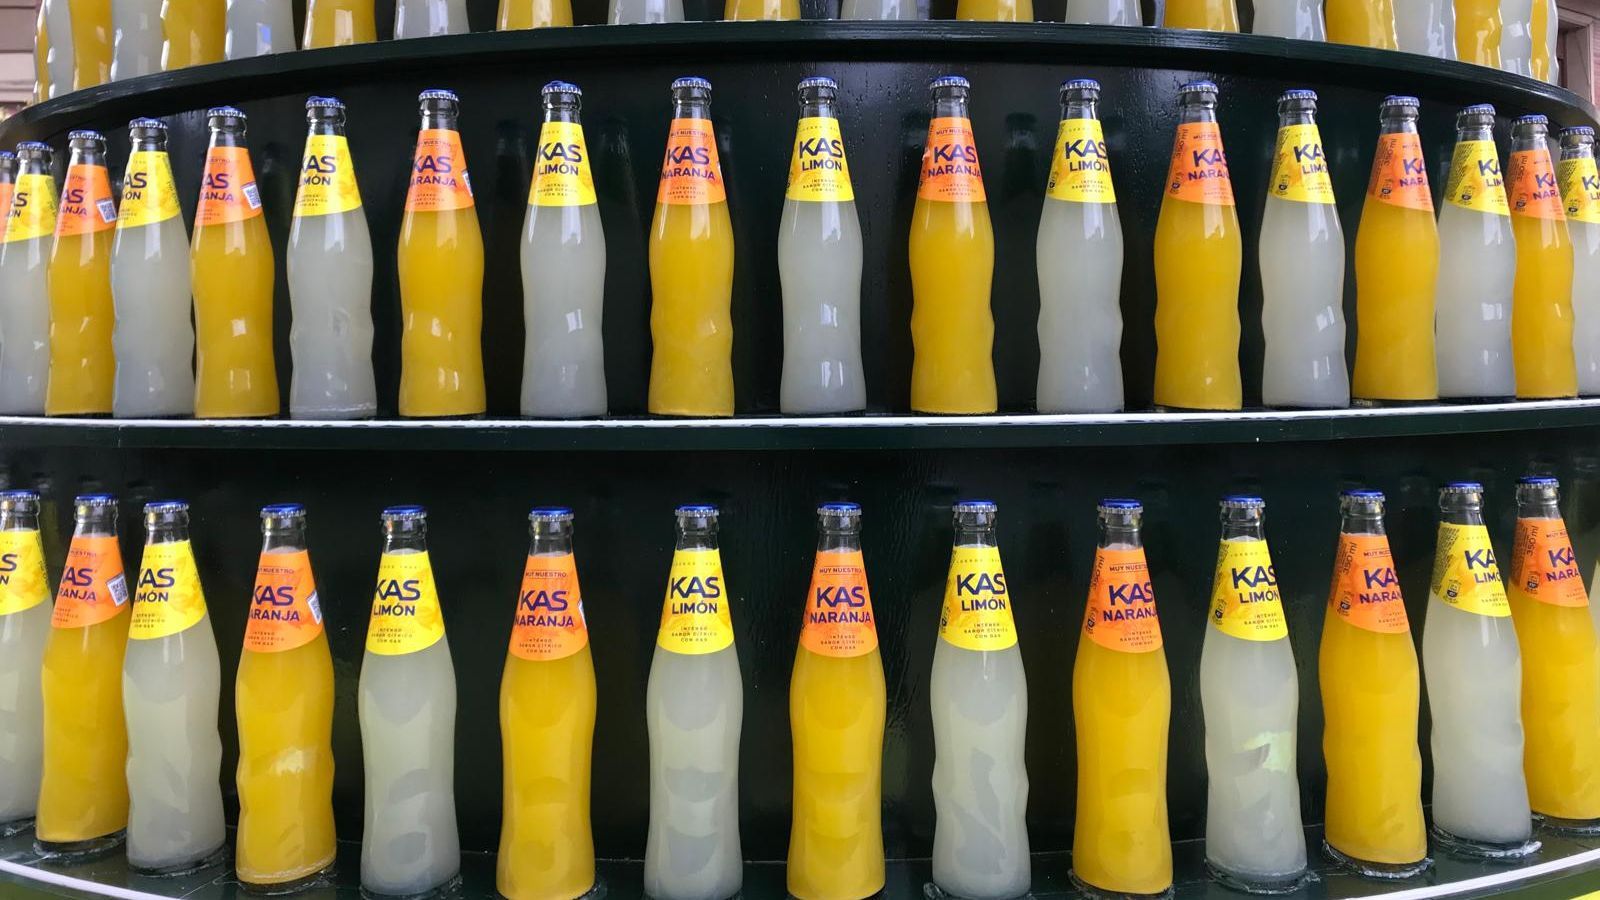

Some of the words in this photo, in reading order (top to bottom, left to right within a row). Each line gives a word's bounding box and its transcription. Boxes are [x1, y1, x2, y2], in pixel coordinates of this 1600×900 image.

[538, 142, 582, 163] KAS
[667, 146, 710, 166] KAS
[800, 138, 842, 158] KAS
[934, 144, 976, 163] KAS
[1065, 140, 1107, 159] KAS
[1294, 144, 1326, 163] KA
[539, 163, 579, 176] LIMÓN
[662, 168, 715, 180] NARANJA
[802, 158, 842, 171] LIMÓN
[1070, 160, 1108, 172] LIMÓN
[1403, 158, 1425, 175] KA
[123, 172, 148, 188] AS
[202, 173, 229, 189] AS
[1188, 168, 1229, 181] NARA
[63, 189, 84, 203] AS
[1464, 549, 1496, 570] KA
[1548, 546, 1575, 568] KA
[62, 566, 93, 586] AS
[139, 568, 175, 588] AS
[956, 573, 1006, 596] KAS
[1232, 565, 1277, 590] KAS
[1364, 568, 1398, 589] KA
[1546, 569, 1579, 582] NARA
[376, 580, 420, 601] KAS
[671, 576, 720, 599] KAS
[816, 586, 865, 608] KAS
[1108, 582, 1154, 606] KAS
[1240, 590, 1280, 604] LIMÓN
[374, 603, 416, 616] LIMÓN
[520, 590, 568, 612] KAS
[672, 600, 718, 614] LIMÓN
[962, 597, 1006, 611] LIMÓN
[514, 616, 574, 627] NARANJA
[810, 612, 871, 624] NARANJA
